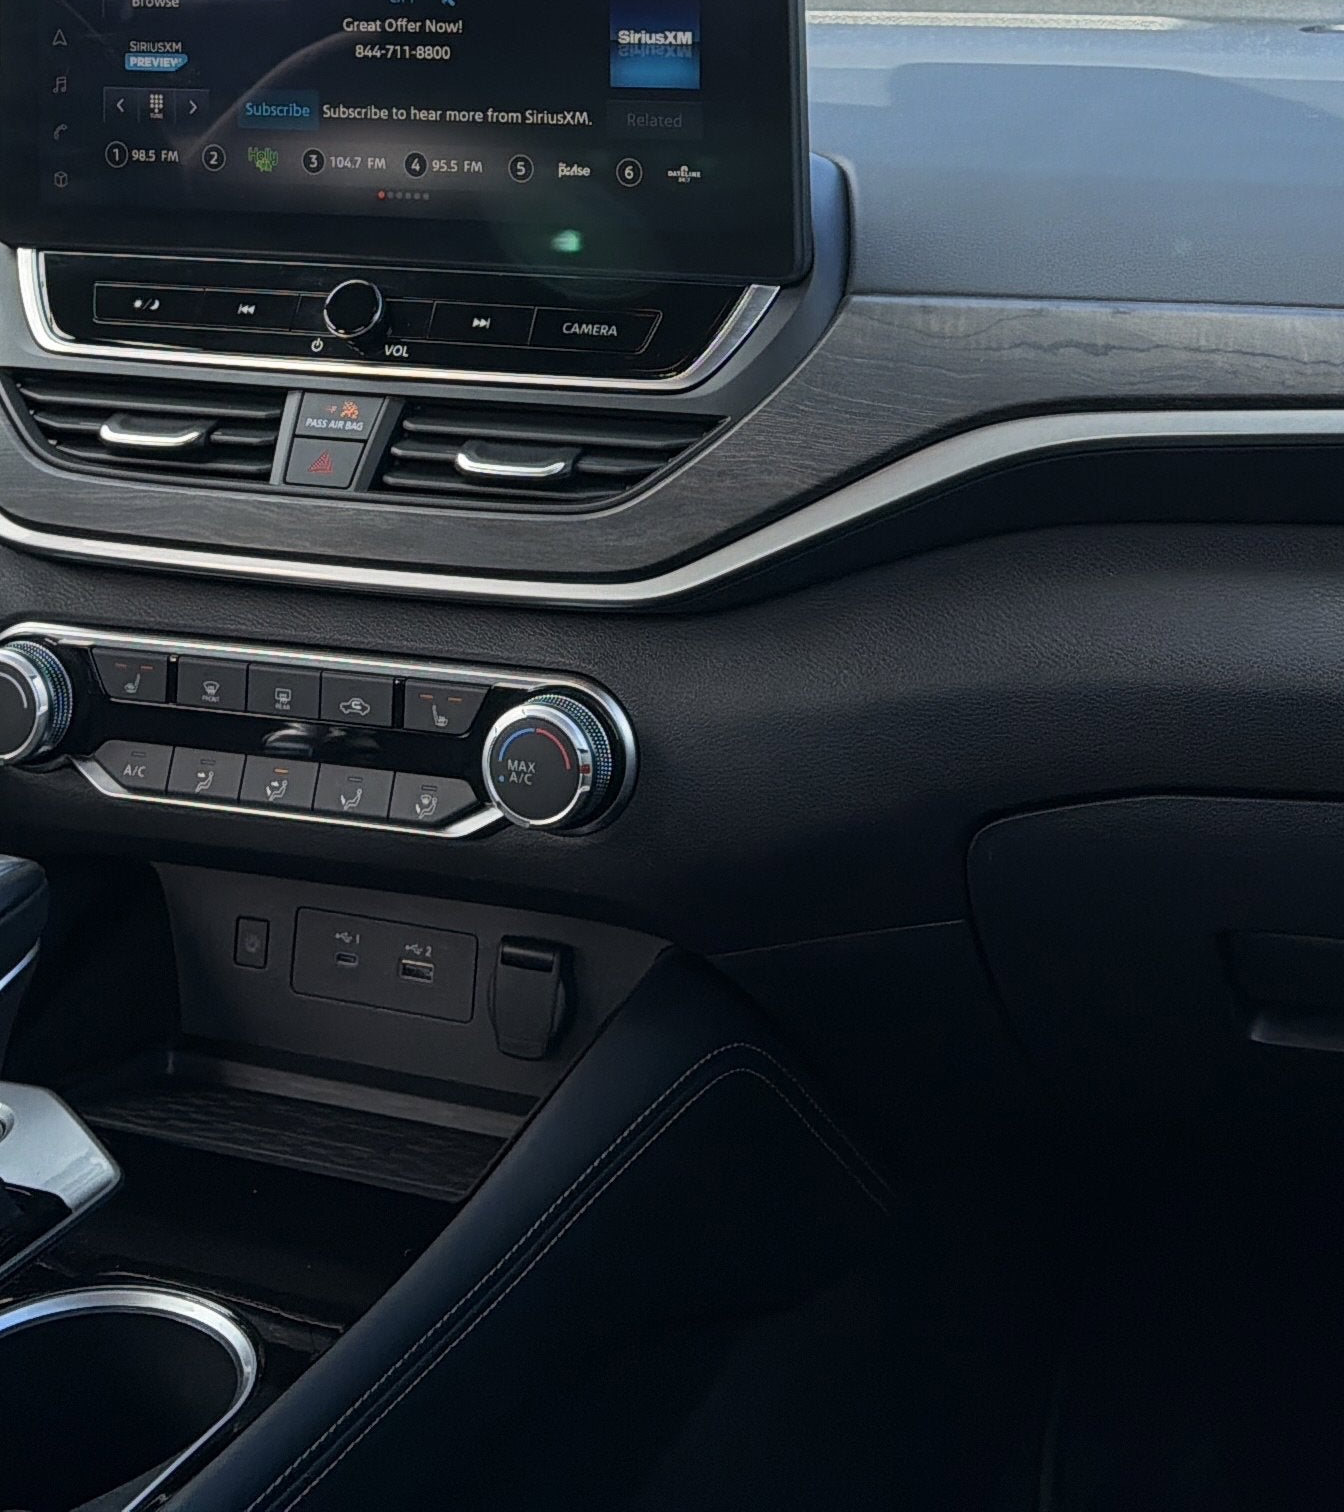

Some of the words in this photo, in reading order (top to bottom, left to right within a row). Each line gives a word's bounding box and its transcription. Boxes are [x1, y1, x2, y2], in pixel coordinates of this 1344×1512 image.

[343, 18, 380, 32] Great
[385, 18, 421, 33] Offer
[425, 19, 463, 33] Now!
[618, 30, 692, 45] SiriusXM
[129, 41, 182, 53] SIRIUSXM
[354, 44, 451, 60] 844-711-8800
[129, 57, 179, 68] PREVIEW
[245, 102, 310, 117] Subscribe
[323, 104, 389, 120] Subscribe
[392, 109, 406, 121] to
[410, 106, 442, 122] hear
[446, 111, 483, 122] more
[487, 108, 521, 124] from
[525, 109, 593, 126] SiriusXM.
[627, 112, 683, 128] Related
[132, 149, 156, 162] 98.5
[161, 150, 179, 163] FM
[309, 155, 318, 168] 3
[329, 156, 362, 169] 104.7
[367, 157, 386, 170] FM
[411, 159, 420, 172] 4
[432, 159, 458, 172] 95.5
[463, 160, 483, 173] FM
[517, 162, 525, 175] 5
[625, 166, 634, 179] 6
[563, 322, 618, 337] CAMERA
[385, 344, 409, 358] VOL
[305, 417, 326, 429] PASS
[328, 419, 343, 430] AIR
[345, 420, 364, 431] BAG
[123, 764, 146, 778] A/C
[508, 759, 536, 774] MAX
[508, 772, 533, 786] A/C
